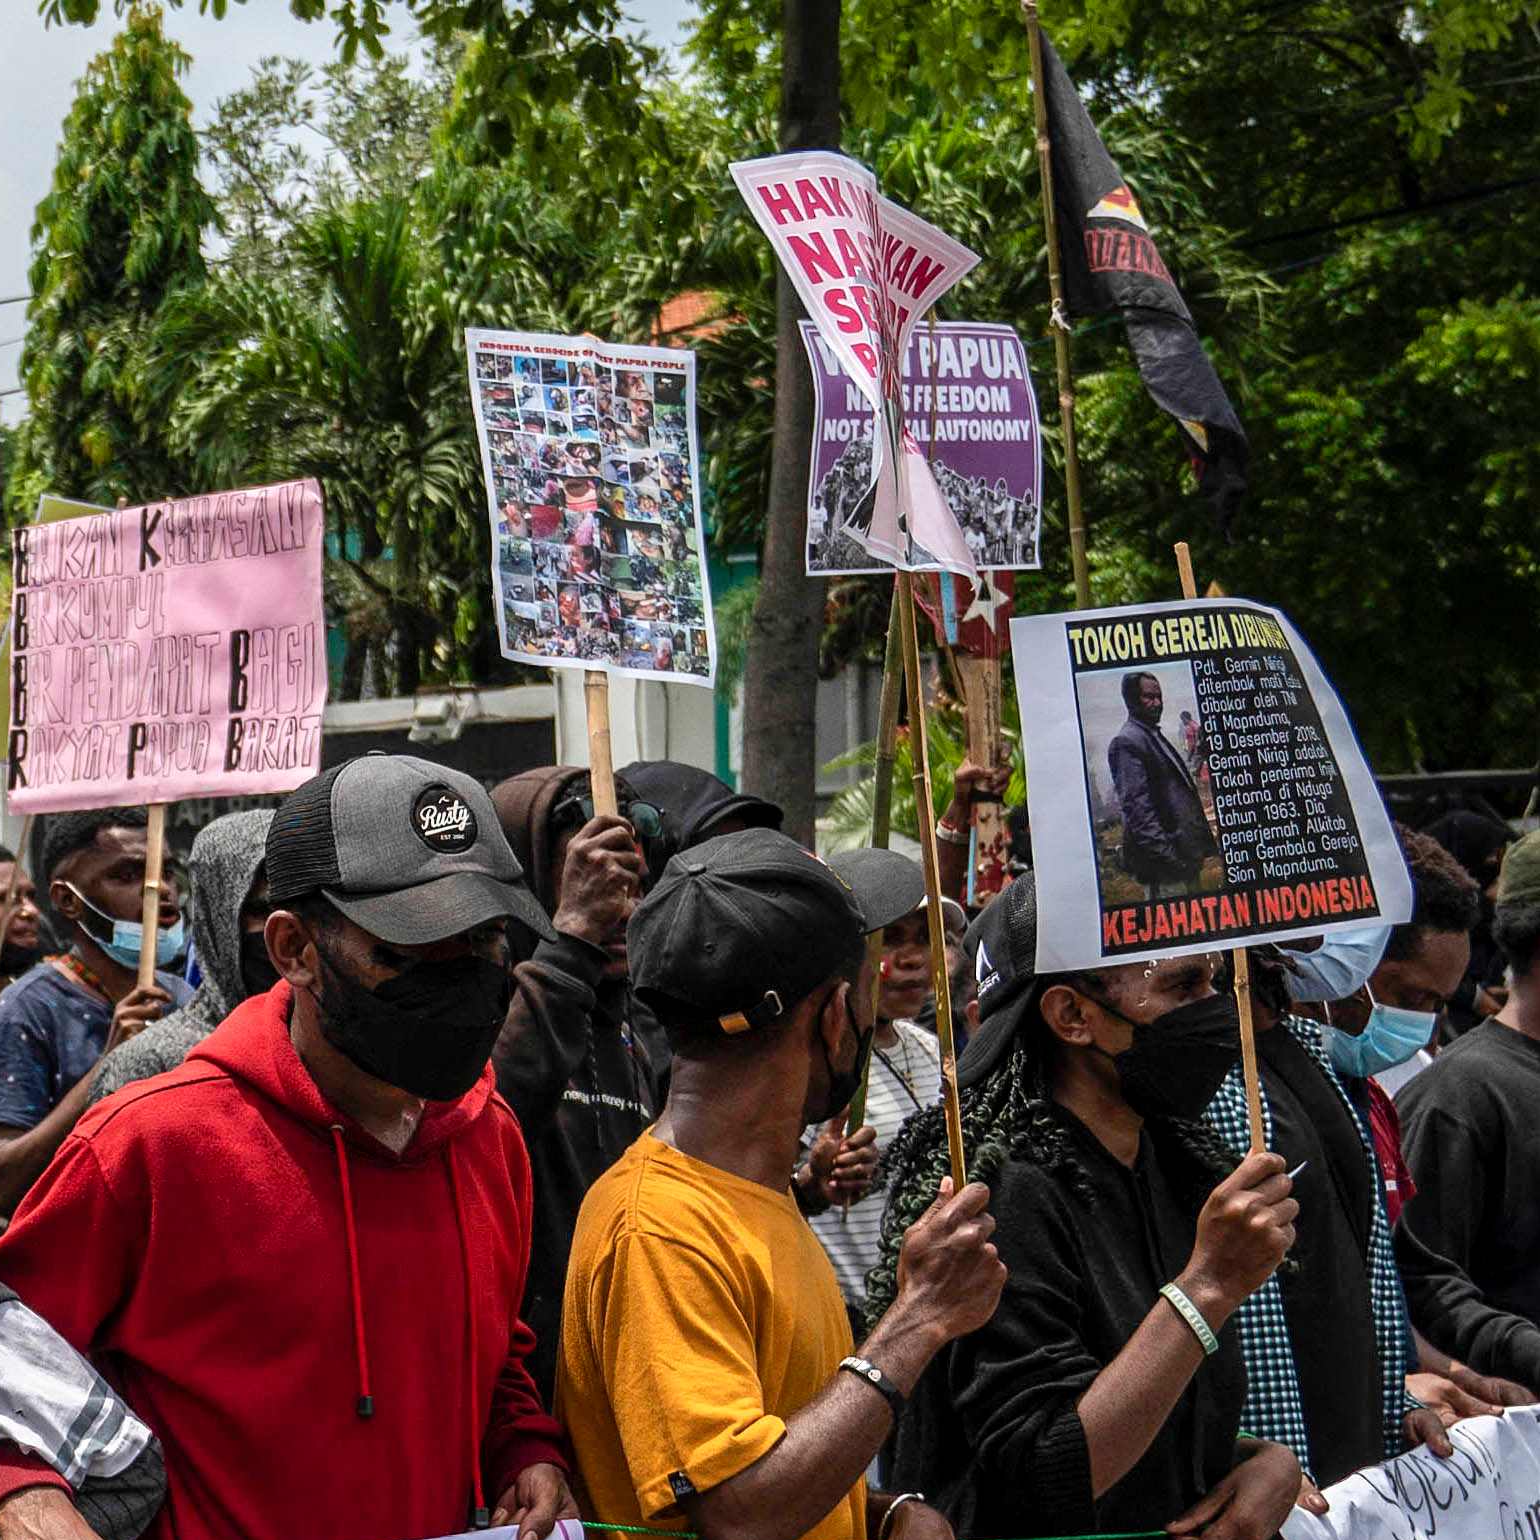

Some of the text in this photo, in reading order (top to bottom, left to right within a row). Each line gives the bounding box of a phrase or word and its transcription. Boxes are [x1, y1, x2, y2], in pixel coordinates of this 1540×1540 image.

[757, 176, 853, 225] HAK
[478, 341, 531, 354] INDONESIA
[533, 346, 580, 357] GENOCIDE
[651, 360, 687, 370] PEOPLE
[919, 338, 1023, 380] PAPUA
[824, 419, 860, 441] NOT
[936, 419, 1030, 441] AUTONOMY
[1070, 614, 1232, 665] TOKOH GEREJA
[1197, 674, 1256, 696] ditembak
[1201, 697, 1246, 715] dibakar
[1253, 692, 1279, 708] oleh
[1204, 717, 1218, 733] di
[1206, 729, 1290, 751] 19 Desember
[1209, 752, 1251, 771] Gemin
[1258, 745, 1289, 768] Nirigi
[1211, 763, 1316, 791] Tokoh penerima
[1215, 781, 1333, 809] pertama di Nduga
[420, 799, 472, 832] Rusty
[1219, 798, 1326, 828] tahun 1963. Dia
[1221, 815, 1346, 851] penerjemah Alkitab
[1224, 831, 1359, 866] dan Gembala Gereja
[1227, 865, 1257, 885] Sion
[1103, 874, 1377, 947] KEJAHATAN INDONESIA
